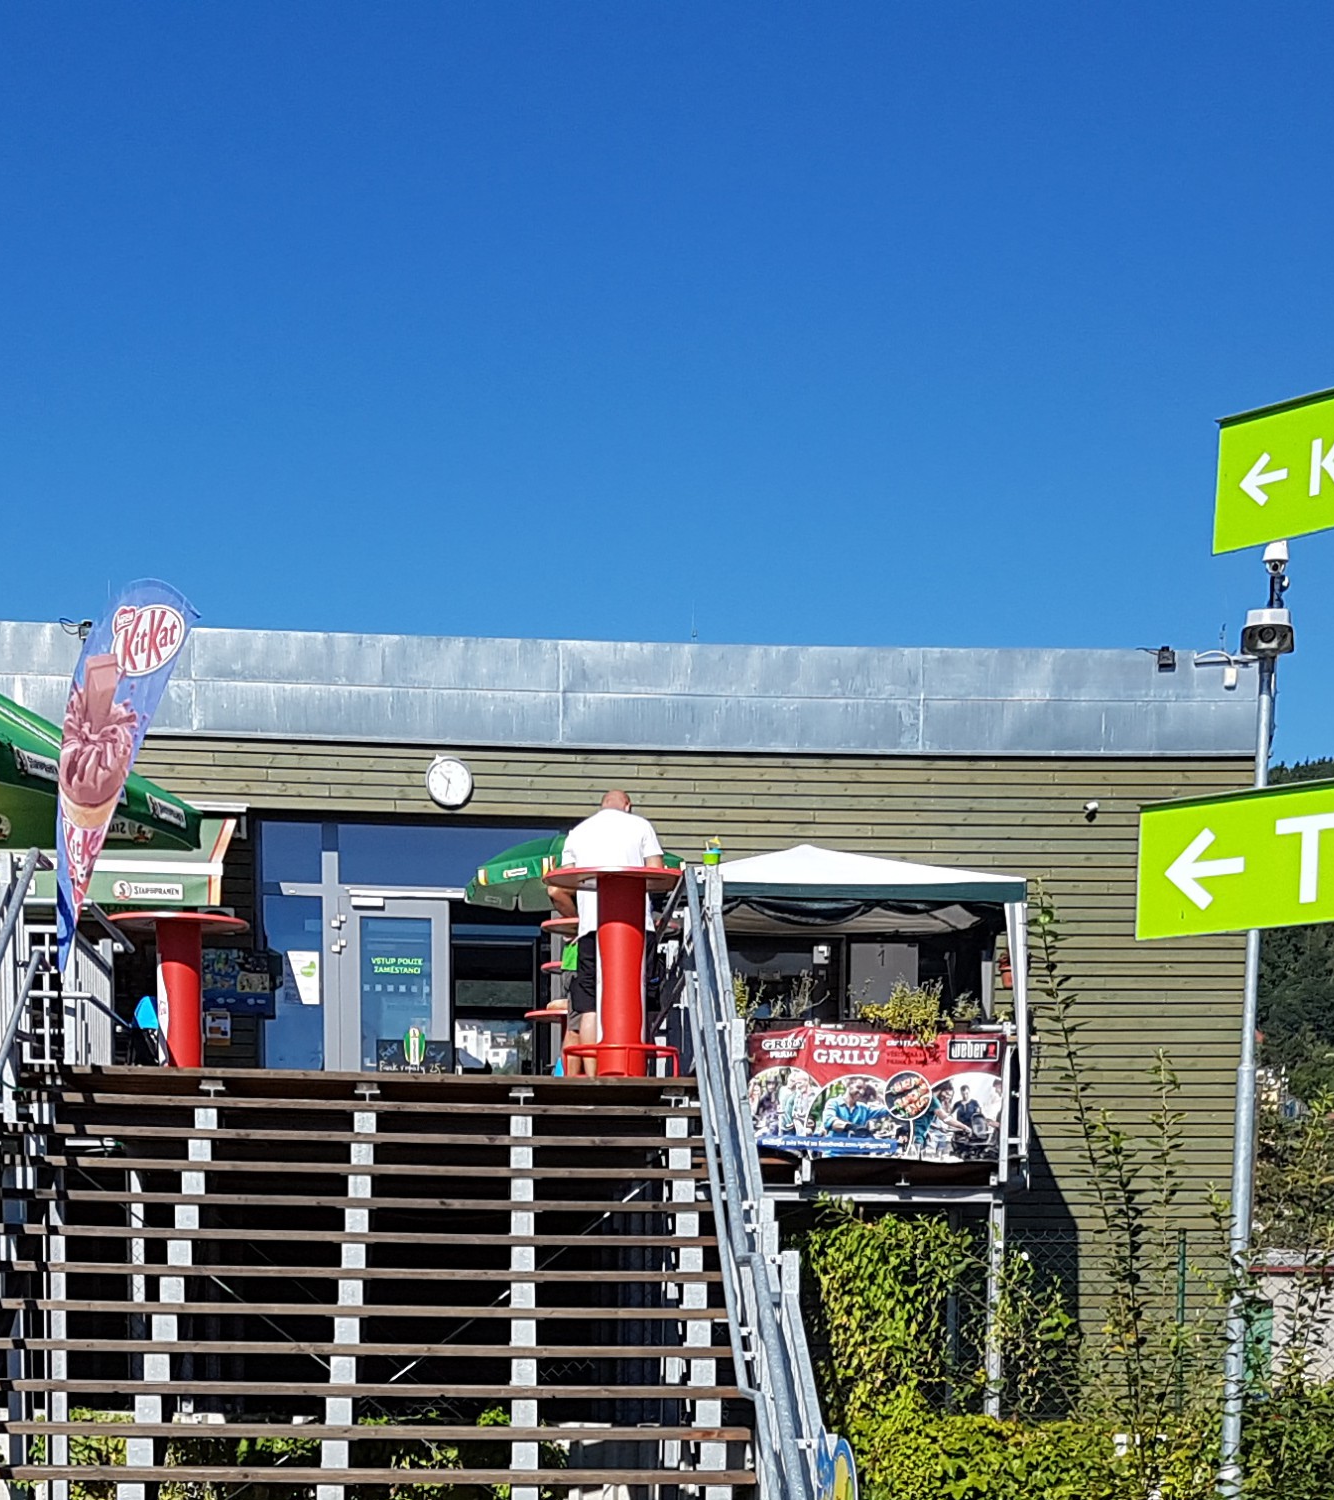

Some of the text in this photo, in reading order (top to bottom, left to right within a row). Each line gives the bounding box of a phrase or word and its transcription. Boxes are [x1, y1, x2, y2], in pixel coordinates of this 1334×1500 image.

[122, 610, 178, 671] KitKat
[370, 957, 424, 966] VSTUP POUZE
[815, 1033, 880, 1048] PRODEJ
[951, 1040, 987, 1059] weber
[813, 1047, 880, 1066] GRILŮ
